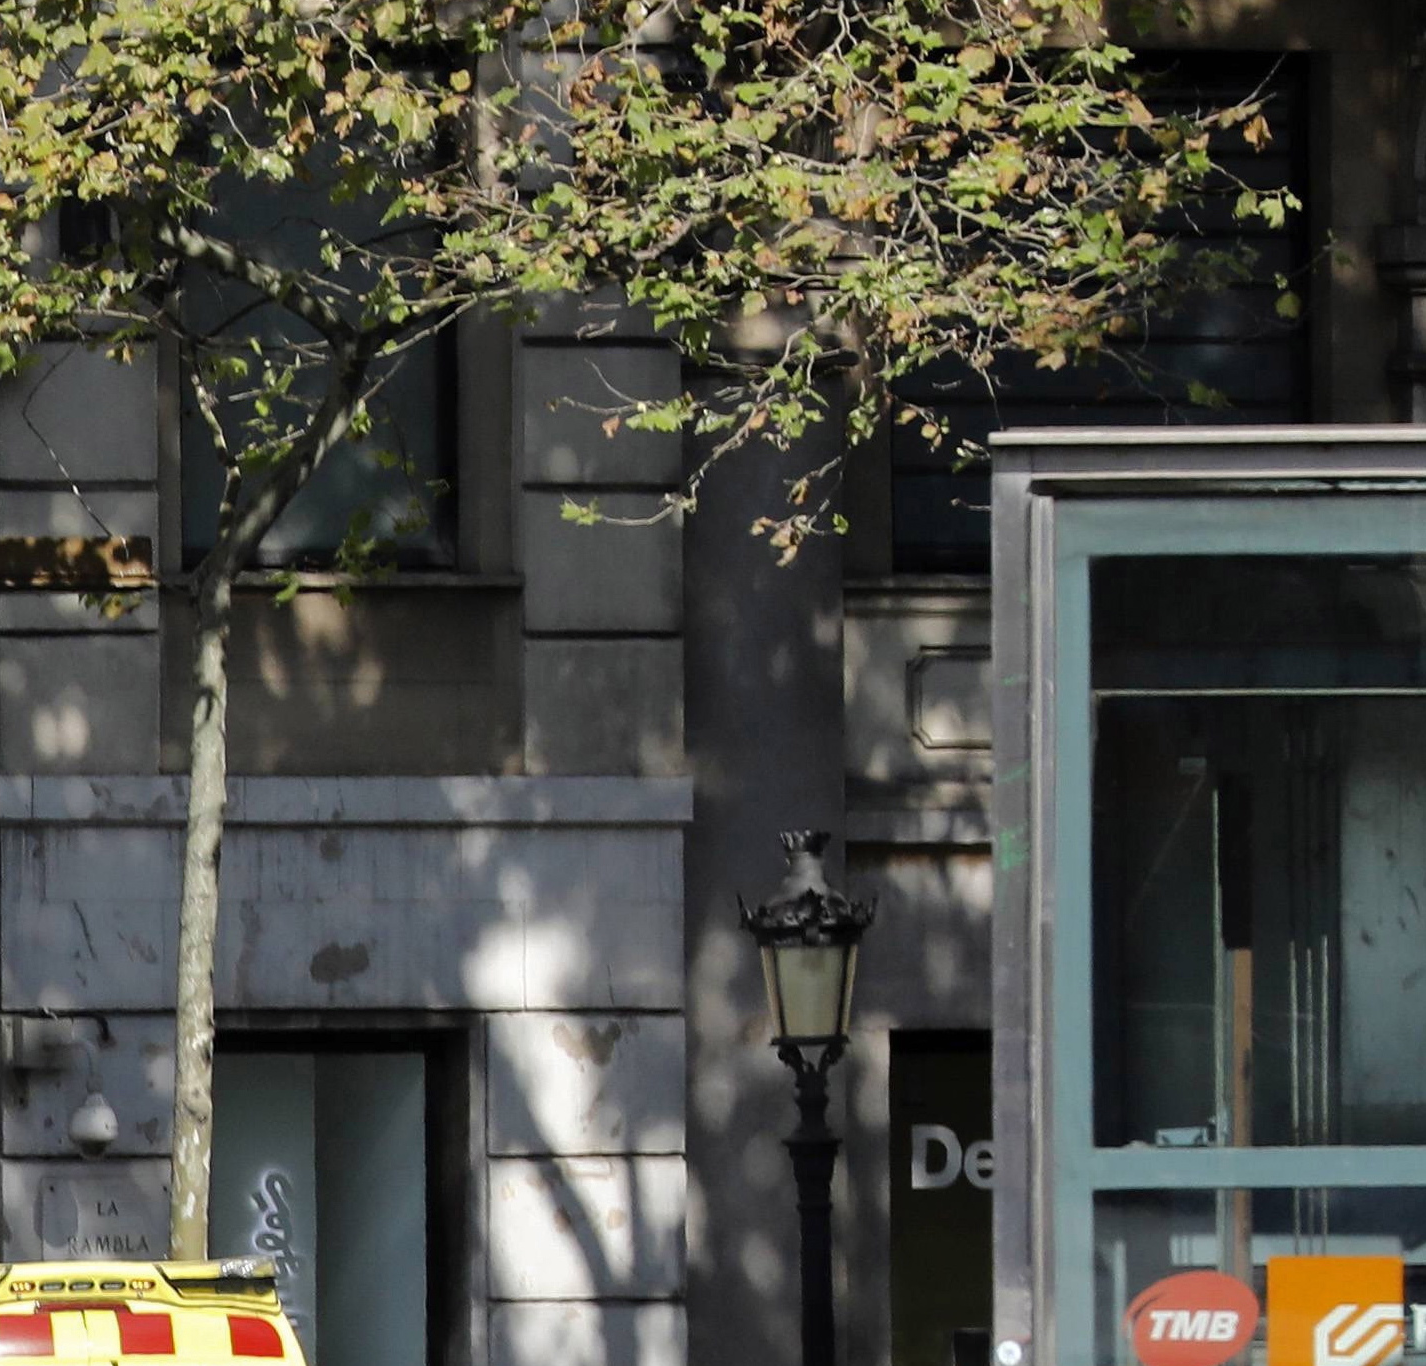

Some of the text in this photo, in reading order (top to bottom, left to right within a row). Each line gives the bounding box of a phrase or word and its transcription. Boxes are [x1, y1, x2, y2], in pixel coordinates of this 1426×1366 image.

[97, 1200, 119, 1217] LA
[66, 1233, 150, 1256] RAMBLA
[1149, 1309, 1239, 1342] TMB
